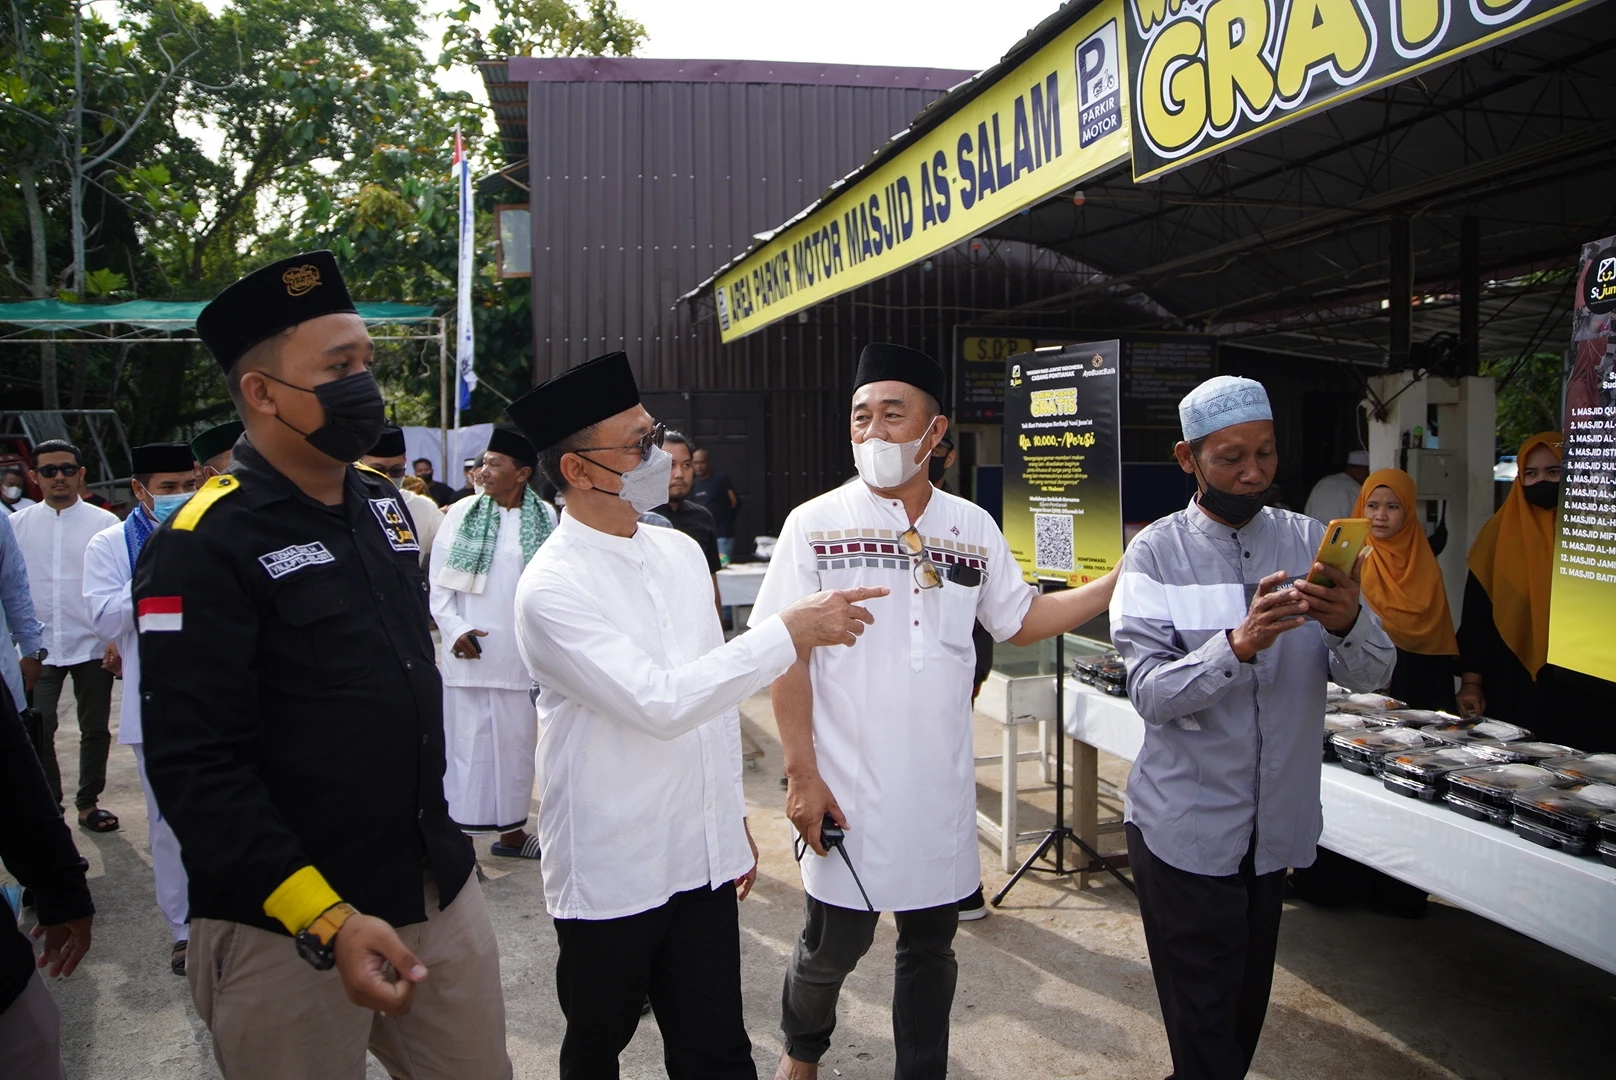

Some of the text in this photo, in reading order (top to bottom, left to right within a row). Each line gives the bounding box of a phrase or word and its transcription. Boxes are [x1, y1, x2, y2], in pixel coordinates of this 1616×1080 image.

[1082, 96, 1115, 125] PARKIR
[1082, 114, 1117, 143] MOTOR
[730, 275, 754, 324] AREA
[753, 250, 793, 312] PARKIR
[793, 220, 844, 291] MOTOR
[844, 175, 913, 268] MASJID
[1049, 370, 1075, 379] PONTIANAK
[1031, 398, 1077, 417] GRATIS
[1577, 407, 1603, 416] MASJID
[1570, 421, 1576, 429] 2.
[1577, 421, 1604, 429] MASJID
[1569, 435, 1575, 443] 3.
[1576, 434, 1602, 443] MASJID
[1568, 448, 1574, 456] 4.
[1575, 448, 1601, 456] MASJID
[1574, 462, 1600, 470] MASJID
[1566, 475, 1572, 483] 6.
[1573, 475, 1599, 483] MASJID
[1565, 488, 1570, 496] 7.
[1571, 488, 1598, 497] MASJID
[1564, 501, 1570, 509] 8.
[1571, 501, 1598, 511] MASJID
[1563, 514, 1569, 522] 9.
[1570, 515, 1596, 525] MASJID
[1562, 527, 1571, 536] 10.
[1572, 528, 1598, 539] MASJID
[1569, 541, 1596, 552] MASJID
[1560, 553, 1569, 562] 12.
[1570, 555, 1596, 566] MASJID
[1559, 566, 1568, 575] 13.
[1568, 568, 1595, 579] MASJID
